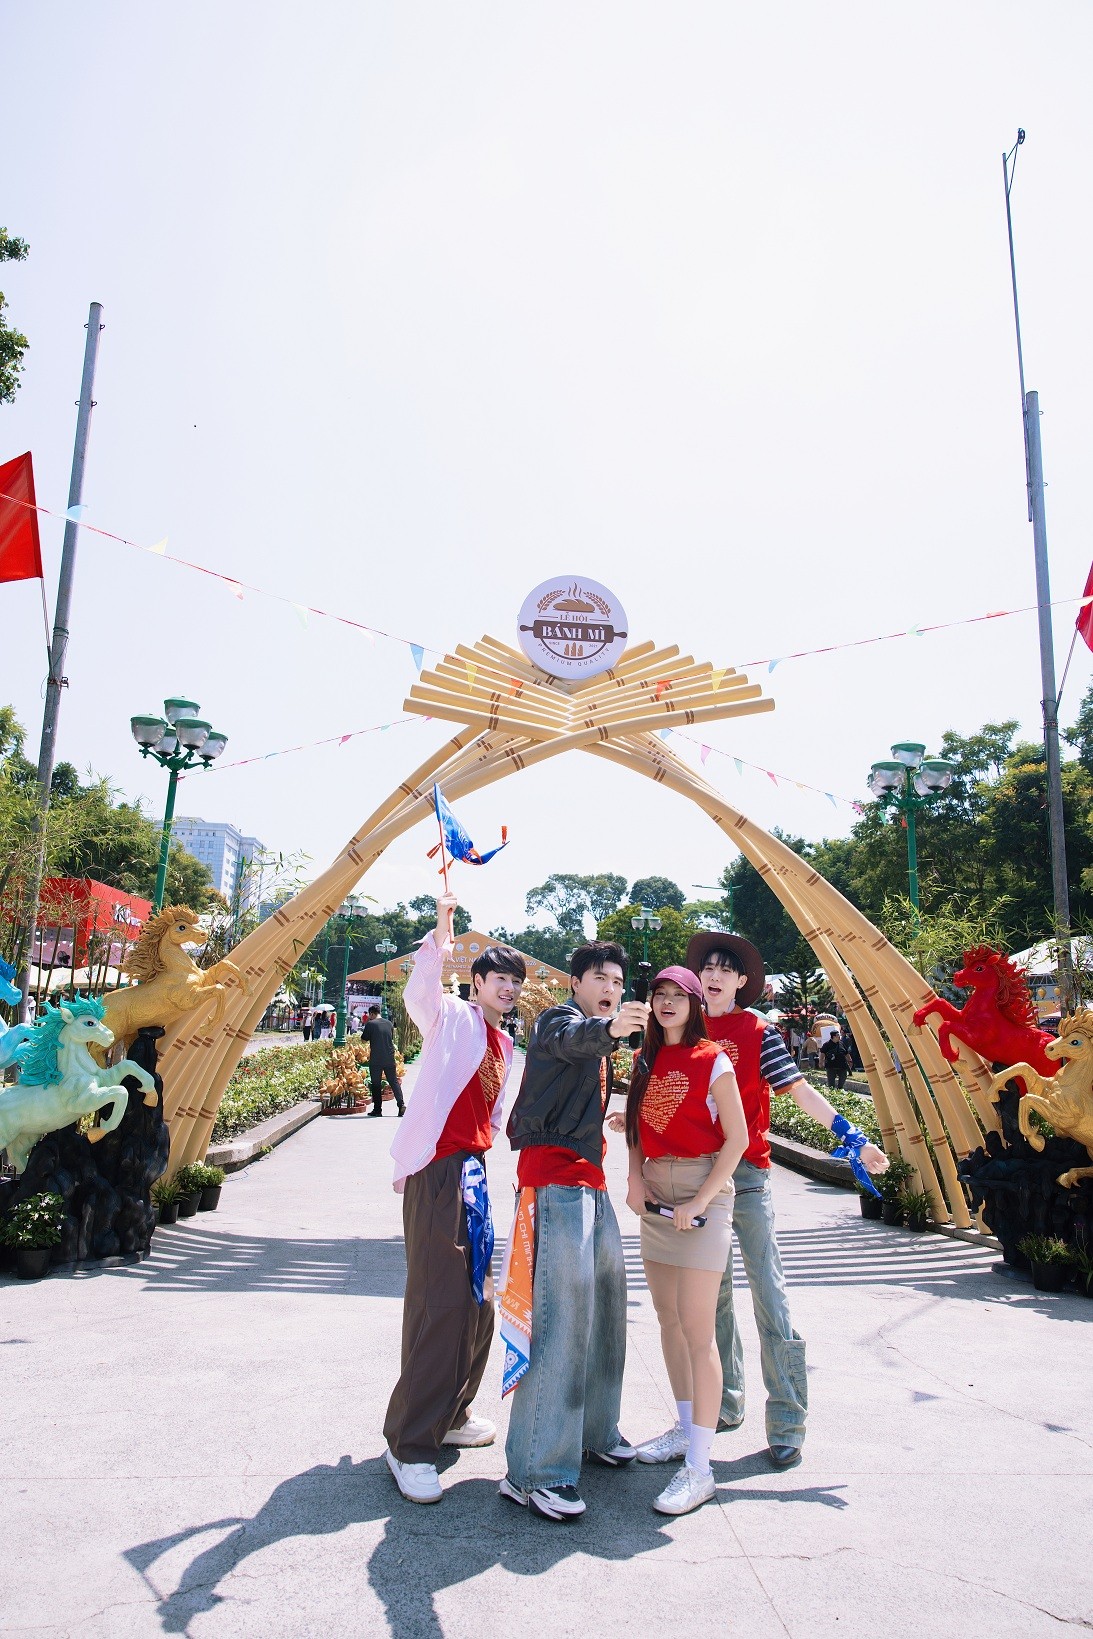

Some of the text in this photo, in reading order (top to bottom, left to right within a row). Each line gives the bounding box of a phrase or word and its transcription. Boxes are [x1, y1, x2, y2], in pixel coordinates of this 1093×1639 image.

[559, 611, 588, 623] LỄ HỘI
[542, 624, 605, 640] BÁNH MÌ
[537, 643, 610, 667] PREMIUM QUALITY
[519, 1223, 529, 1239] CHI
